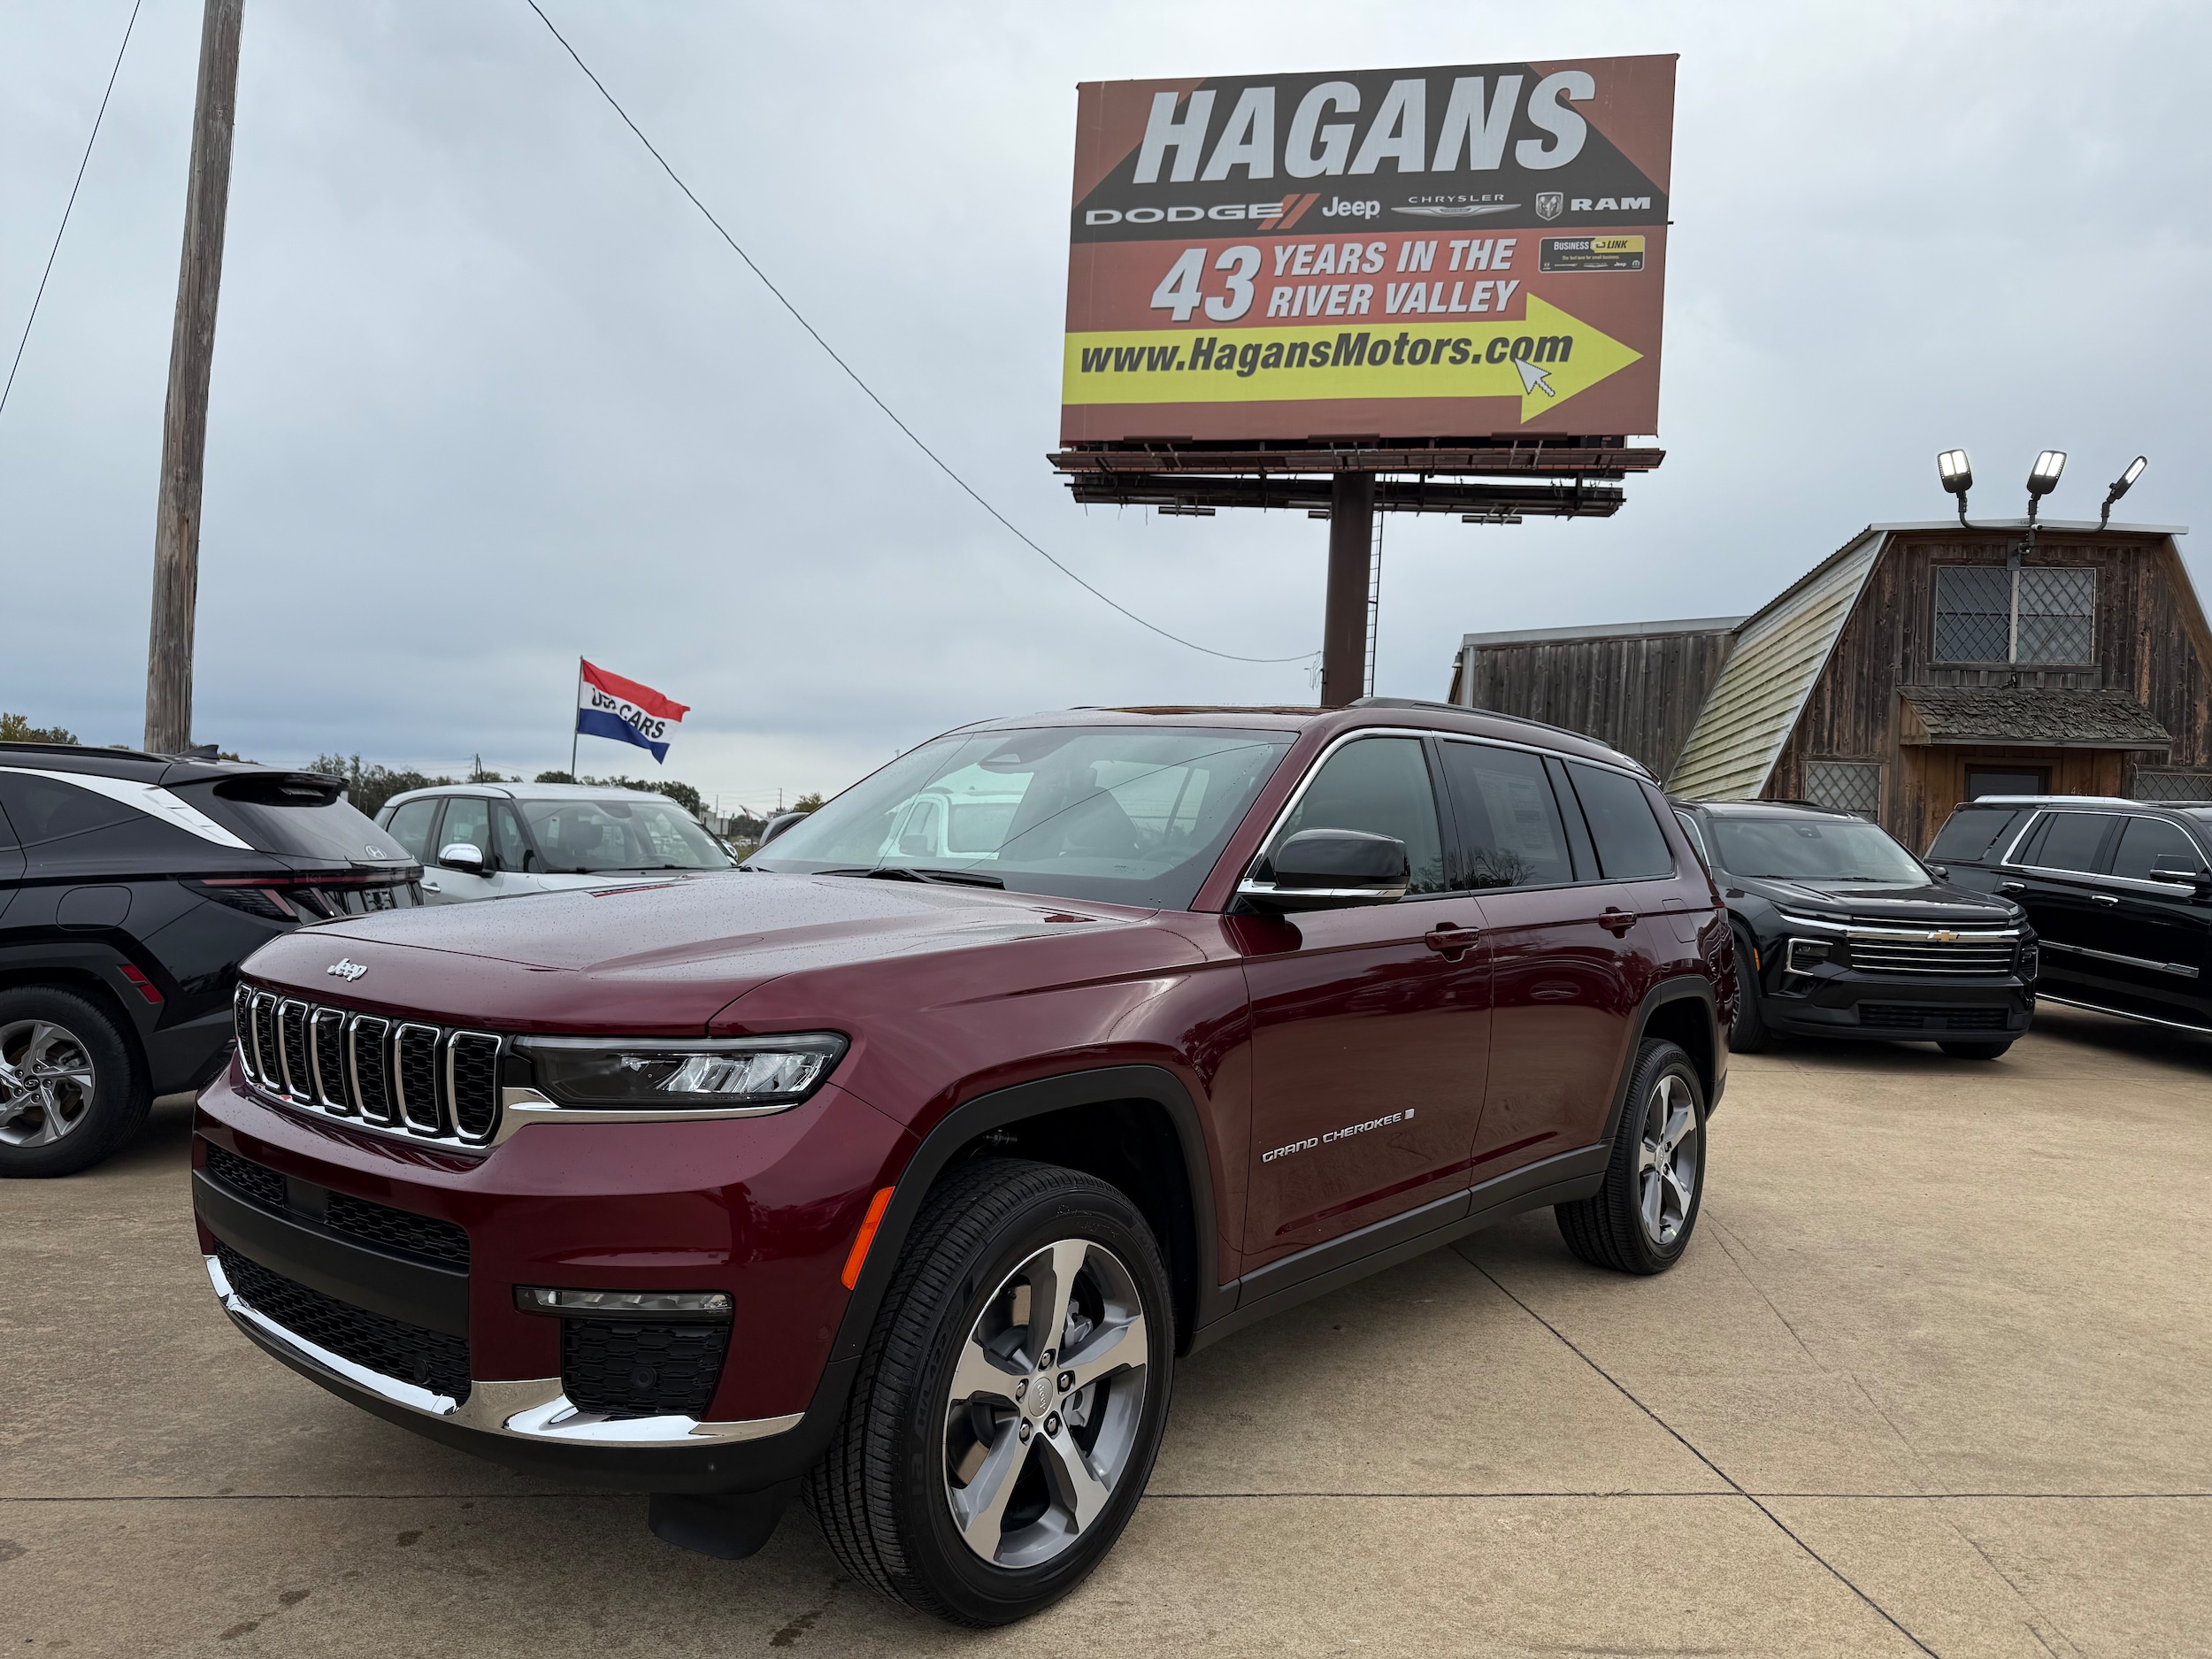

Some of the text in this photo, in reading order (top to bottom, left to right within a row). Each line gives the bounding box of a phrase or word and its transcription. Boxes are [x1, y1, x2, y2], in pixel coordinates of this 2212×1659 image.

[1133, 70, 1595, 184] HAGANS
[1086, 203, 1284, 225] DODGE
[1322, 196, 1380, 219] Jeep
[1409, 194, 1504, 204] CHRYSLER
[1571, 196, 1651, 211] RAM
[1274, 238, 1517, 277] YEARS IN THE
[1554, 240, 1628, 250] BUSINESS LINK
[1150, 245, 1262, 322] 43
[1267, 279, 1520, 319] RIVER VALLEY
[1080, 332, 1573, 378] www.HagansMotors.com
[619, 704, 665, 739] CARS
[326, 957, 368, 982] Jeep
[1262, 1112, 1402, 1164] GRAND CHEROKEE
